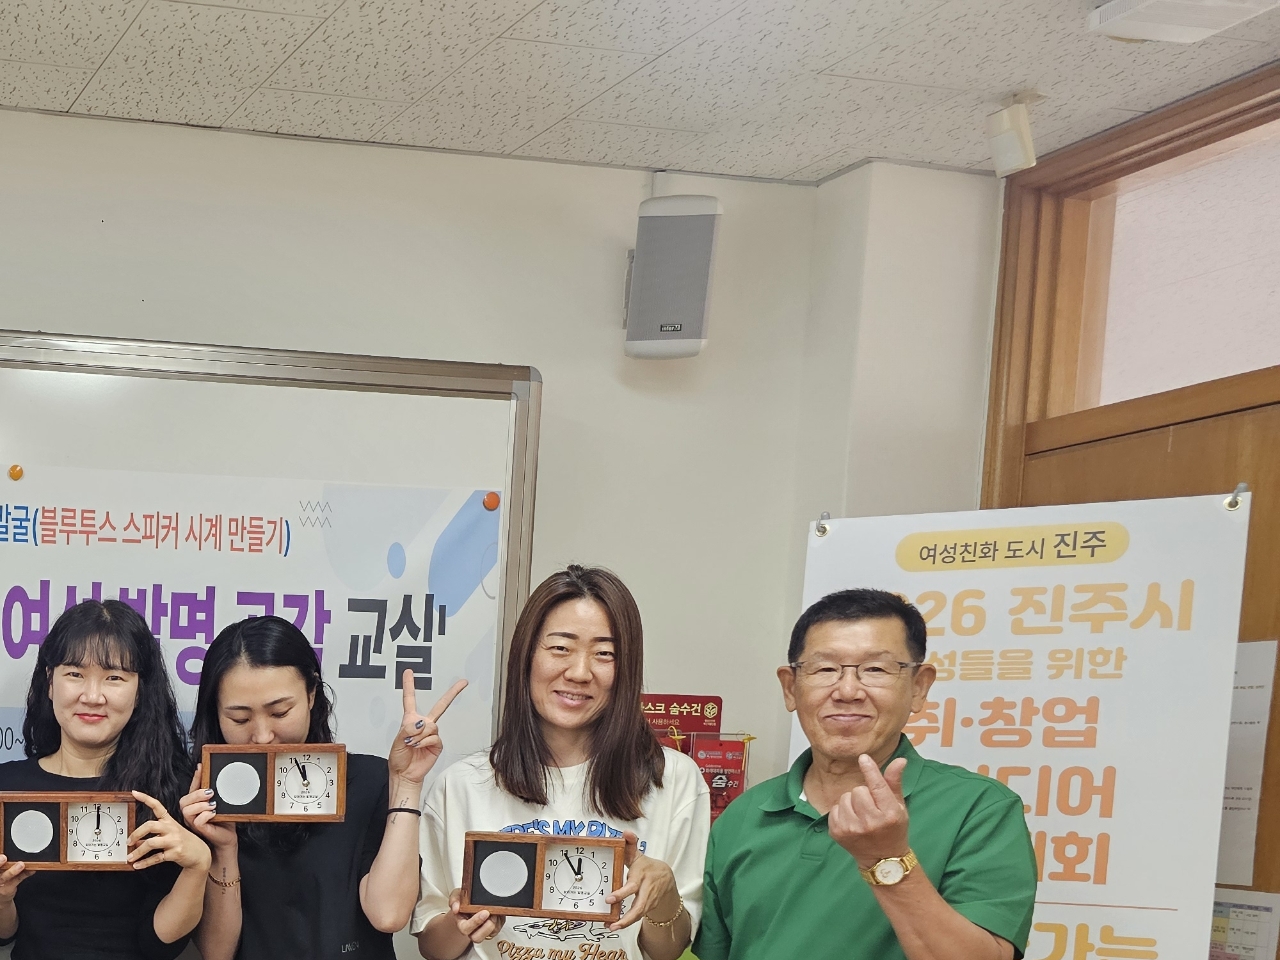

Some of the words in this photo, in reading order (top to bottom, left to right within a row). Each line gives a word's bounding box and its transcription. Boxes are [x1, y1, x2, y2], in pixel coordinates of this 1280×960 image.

[121, 509, 180, 551] 스피커
[184, 514, 222, 552] 시계
[227, 514, 291, 557] 만들기)
[920, 541, 999, 565] 여성친화
[1004, 538, 1046, 561] 도시
[1053, 530, 1108, 559] 진주
[1, 579, 103, 660] 여
[892, 588, 987, 637] 26
[1008, 578, 1196, 637] 진주시
[927, 647, 1034, 682] 성들을
[1046, 646, 1128, 681] 위한
[641, 702, 666, 714] 스크
[669, 703, 702, 716] 숨수건
[977, 764, 1117, 819] 디어
[1029, 830, 1111, 885] 회
